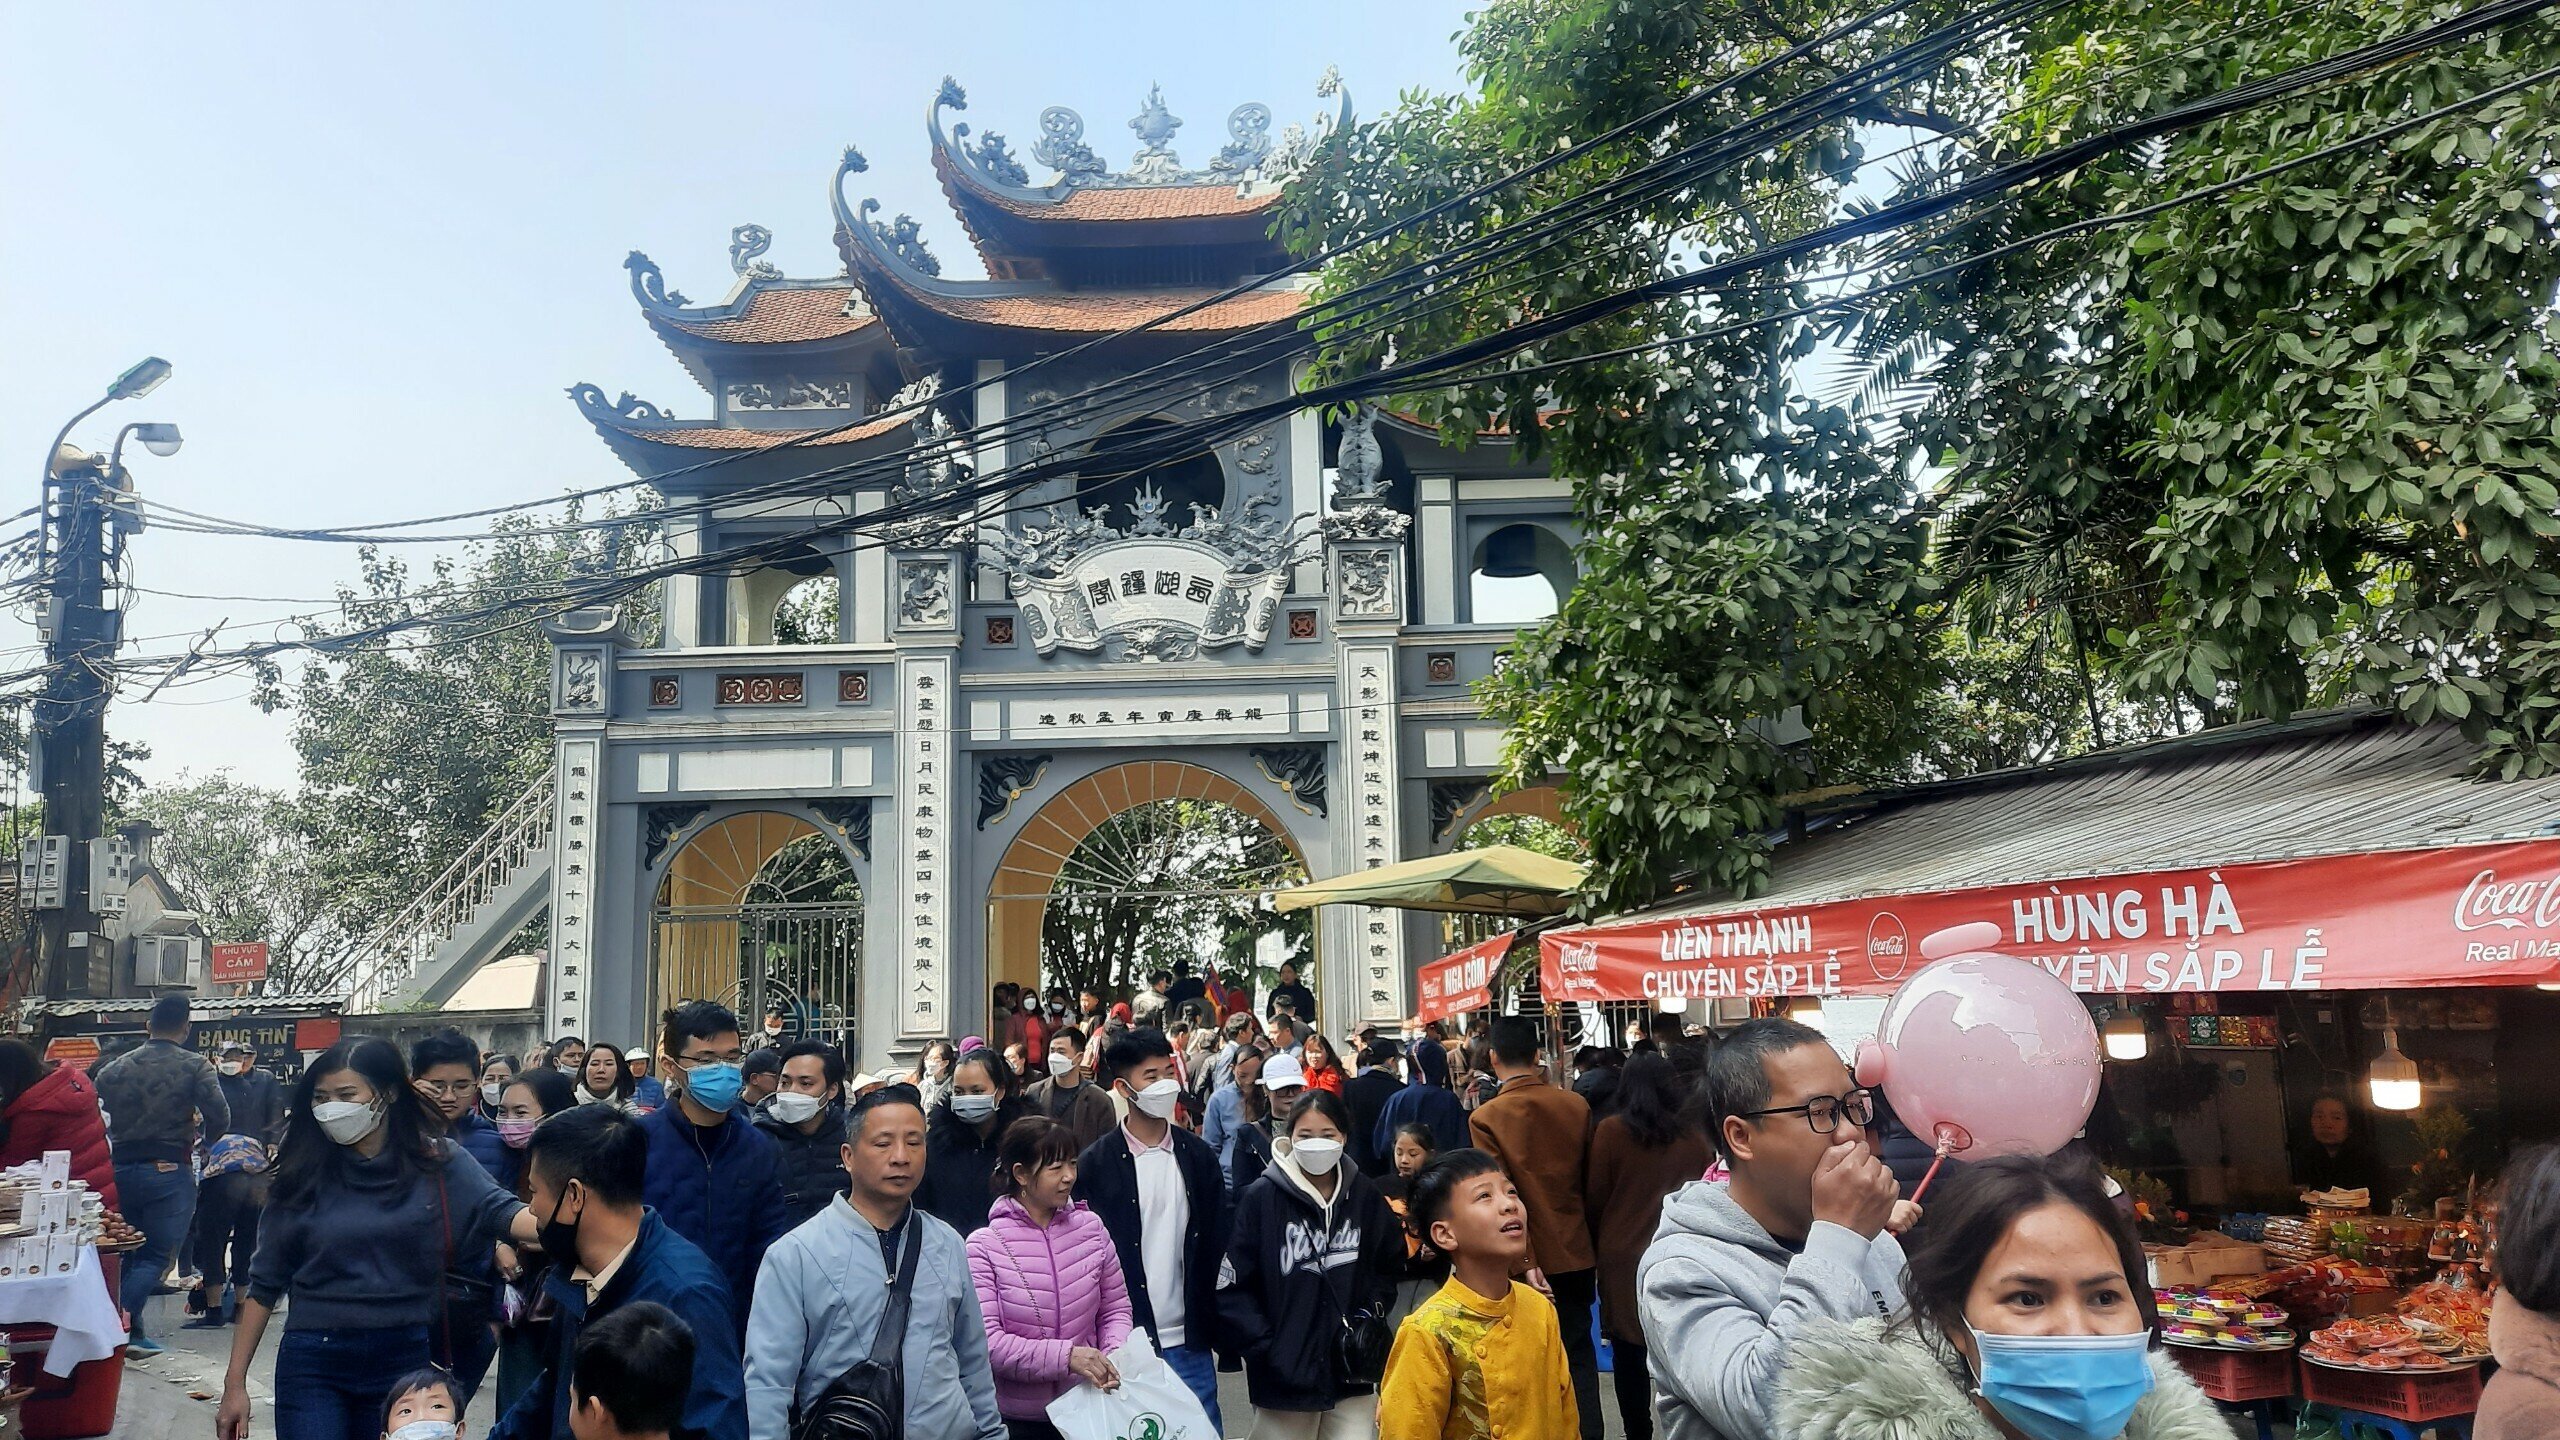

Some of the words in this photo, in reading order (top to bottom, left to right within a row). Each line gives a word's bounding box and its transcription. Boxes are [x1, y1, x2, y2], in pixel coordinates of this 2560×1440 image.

[2012, 886, 2148, 943] HÙNG
[2161, 871, 2245, 937] HÀ
[221, 947, 240, 956] KHU
[1660, 920, 1713, 962] LIÊN
[2257, 928, 2328, 990] LỄ
[2465, 939, 2520, 962] Real
[1444, 965, 1463, 997] NGA
[1642, 962, 1737, 998] CHUYÊN
[1744, 954, 1798, 996] SẮP
[1806, 949, 1842, 994] LỄ
[256, 1027, 288, 1045] TIN
